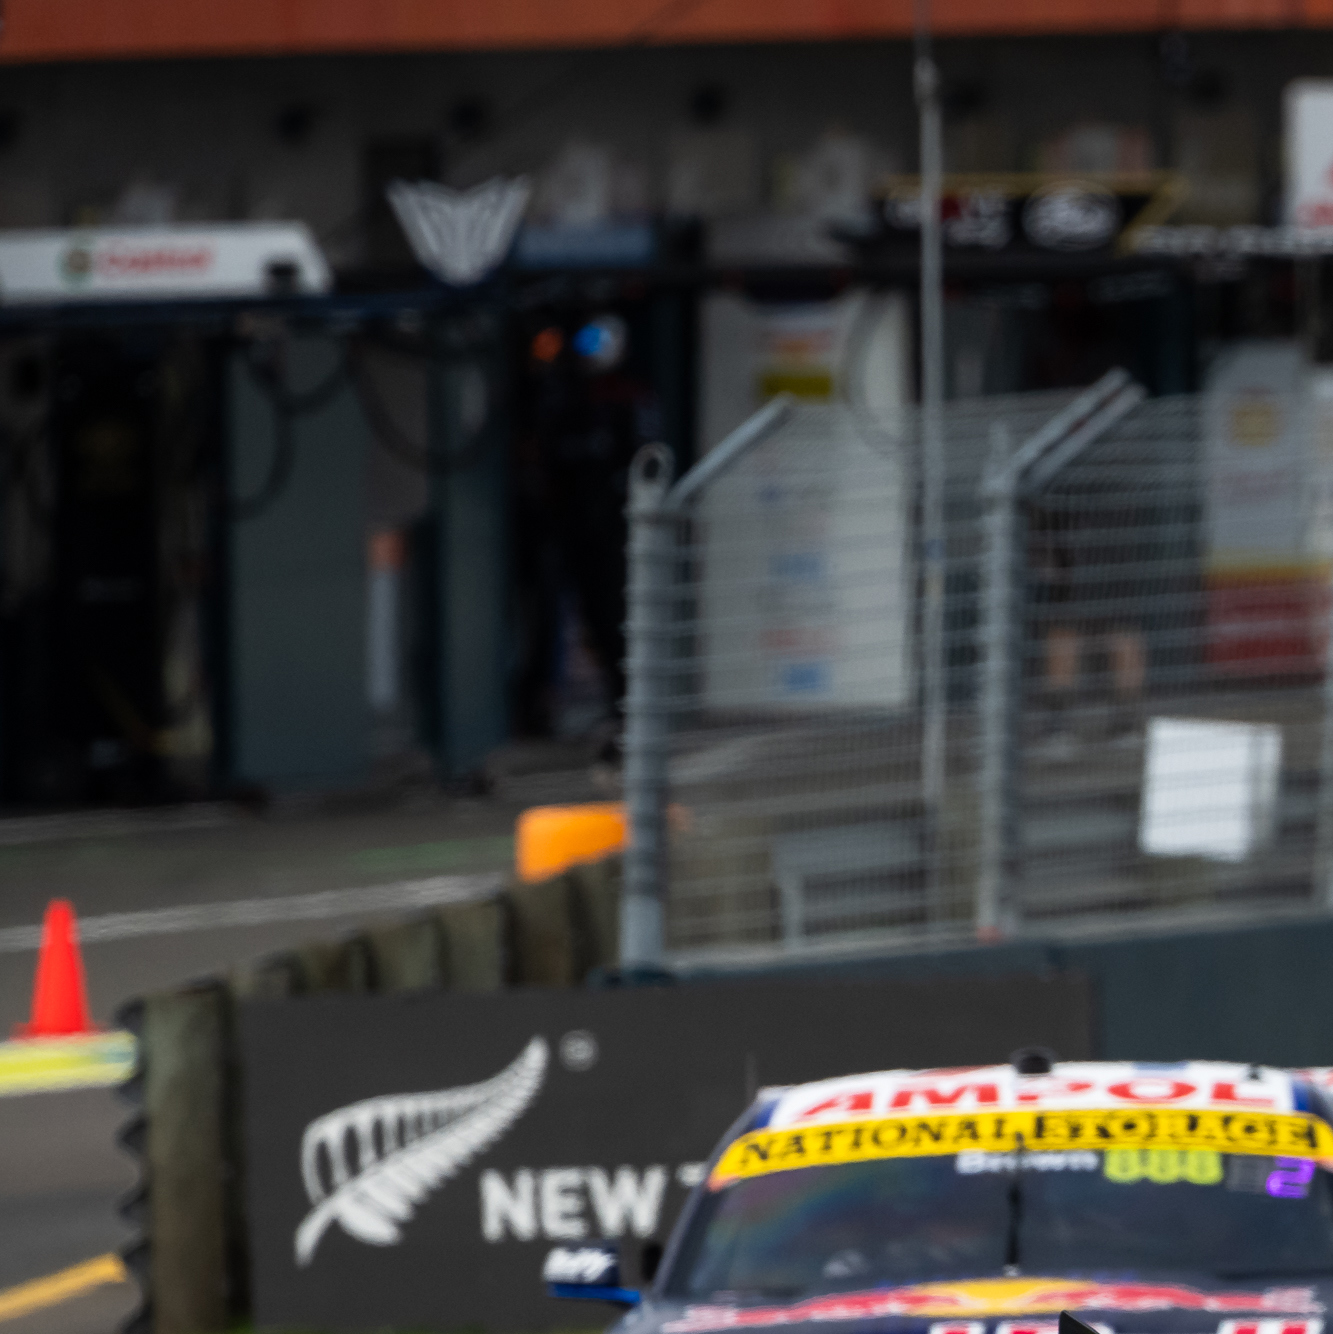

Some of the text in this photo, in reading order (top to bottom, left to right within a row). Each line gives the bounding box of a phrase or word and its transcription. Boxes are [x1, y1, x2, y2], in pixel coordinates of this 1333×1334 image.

[803, 1078, 1275, 1116] AMPOL
[741, 1115, 1010, 1164] NATIONAL
[480, 1164, 667, 1242] NEW
